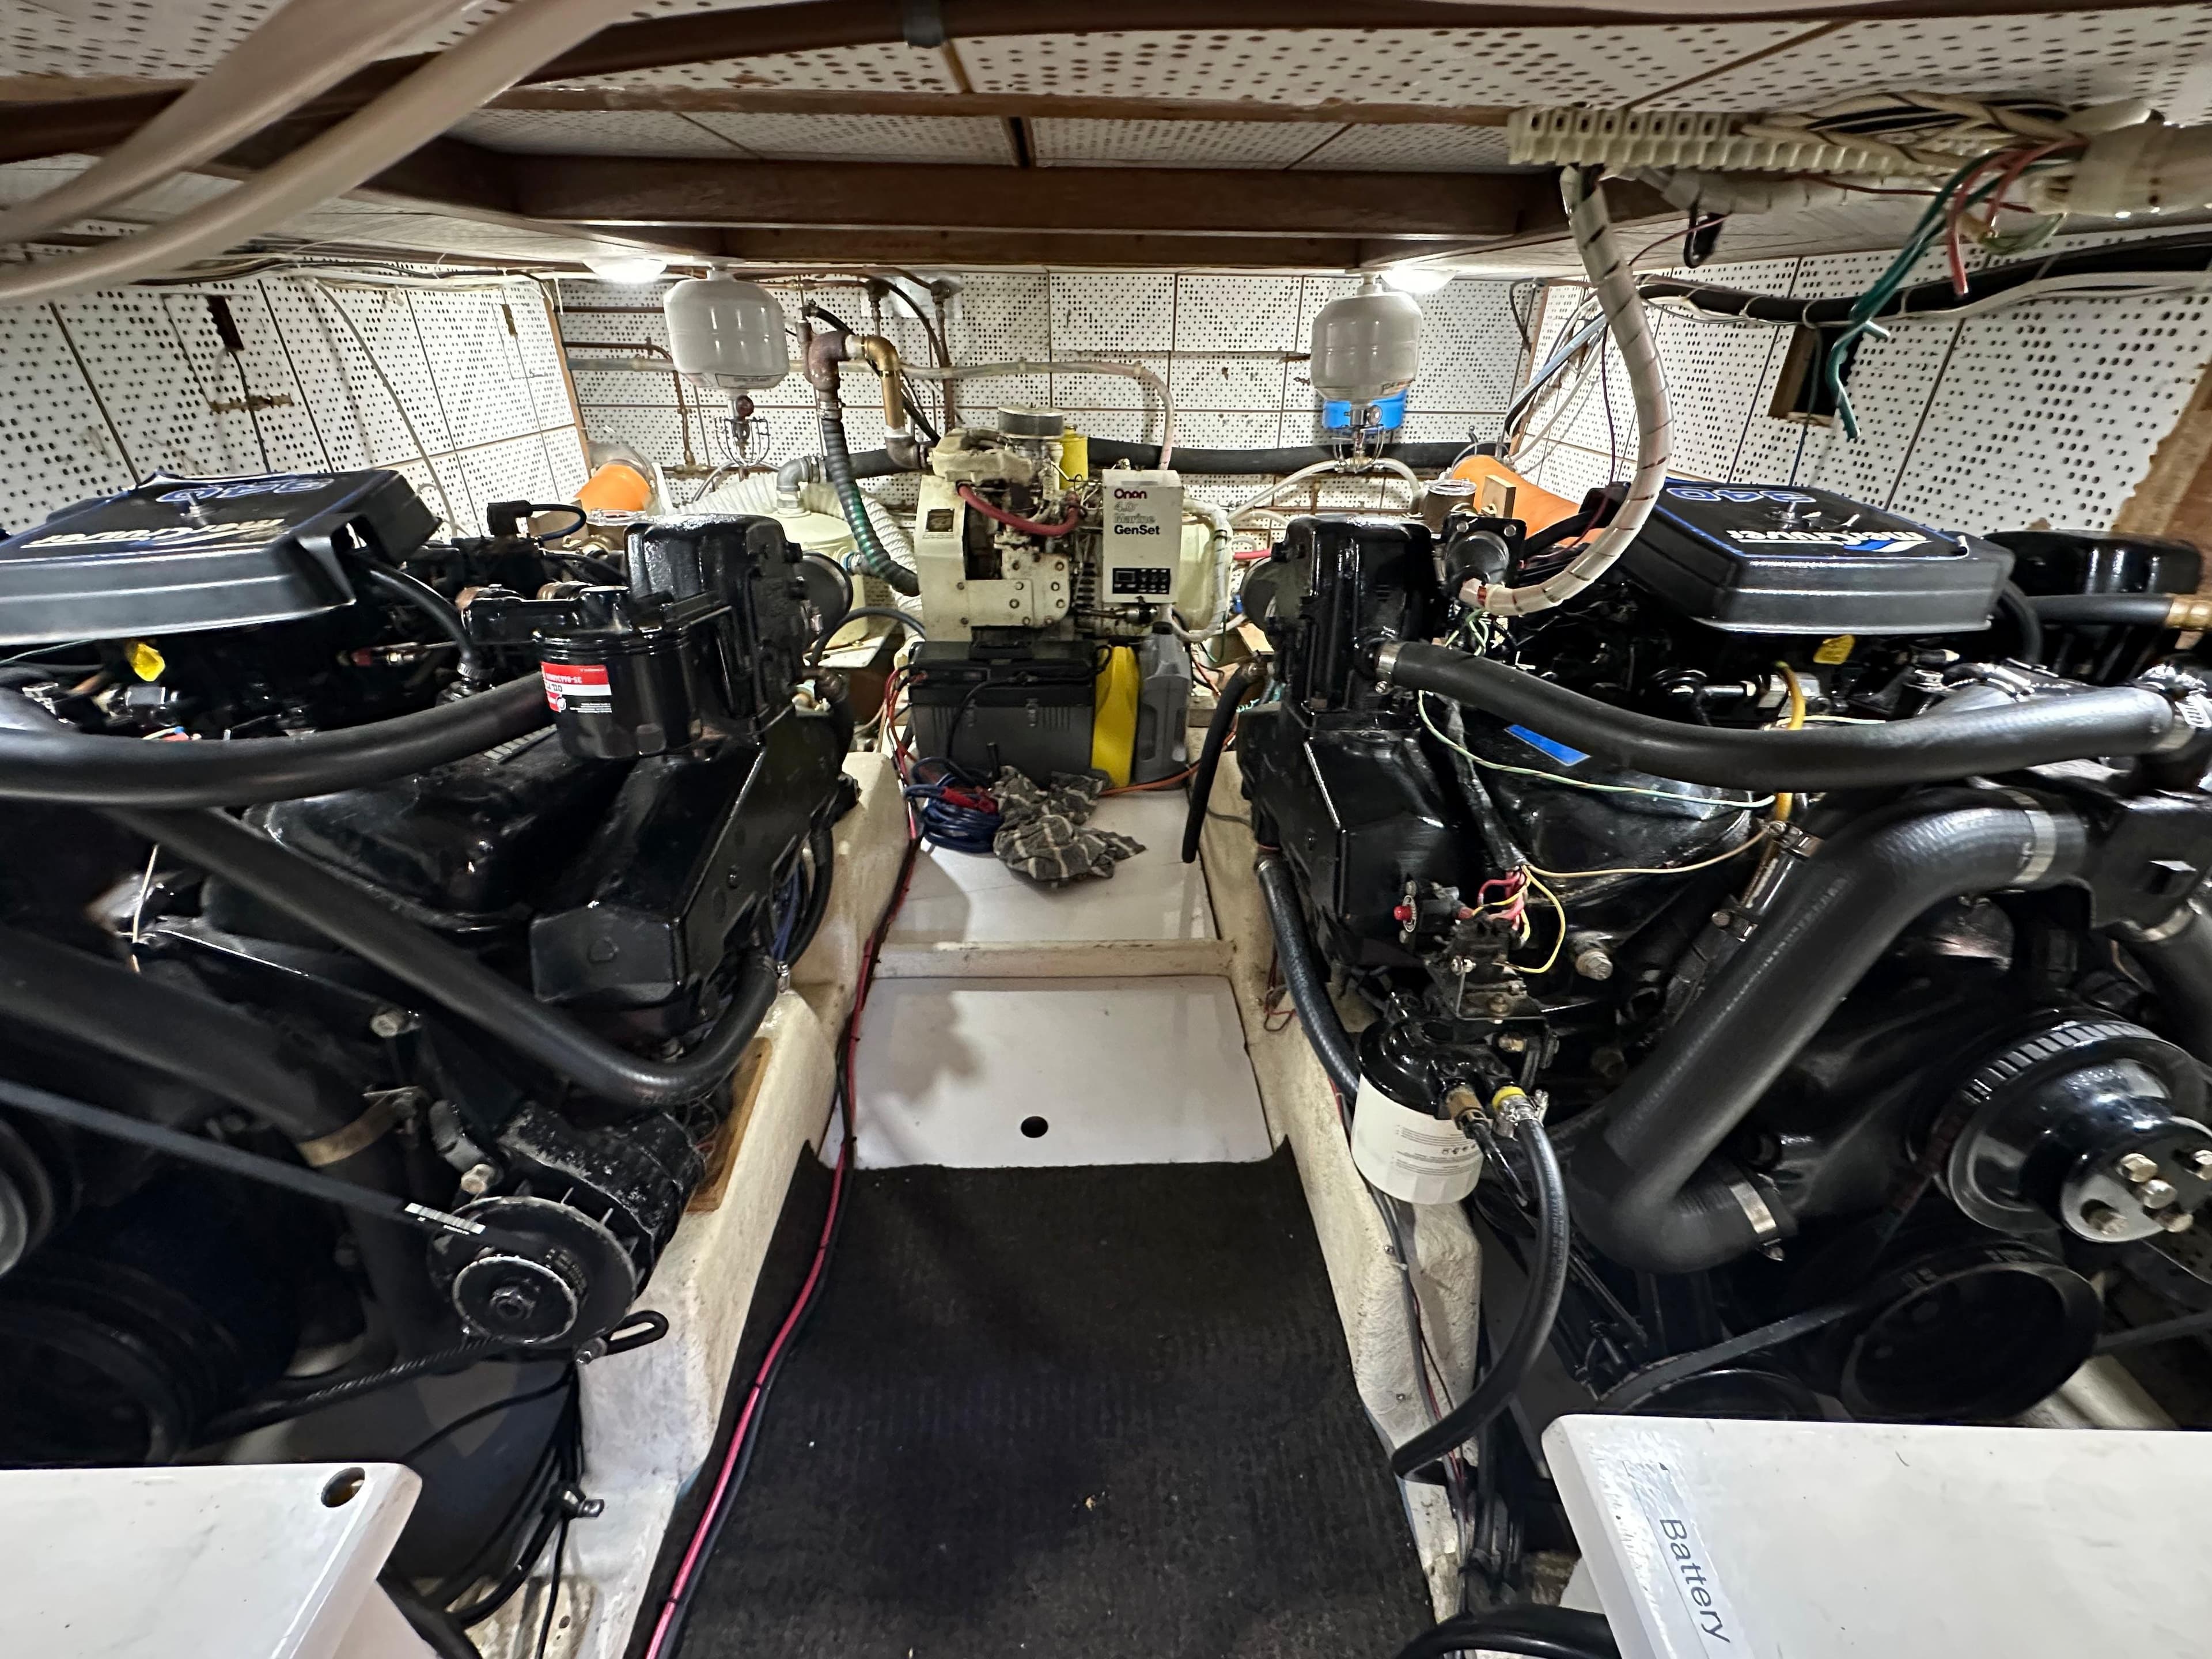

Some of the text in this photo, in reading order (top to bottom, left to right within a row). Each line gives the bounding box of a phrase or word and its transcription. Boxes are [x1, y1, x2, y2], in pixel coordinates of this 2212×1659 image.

[1114, 488, 1147, 499] Onan
[1666, 487, 1816, 503] 340
[1114, 525, 1160, 535] GenSet
[1660, 1519, 1730, 1643] Battery
